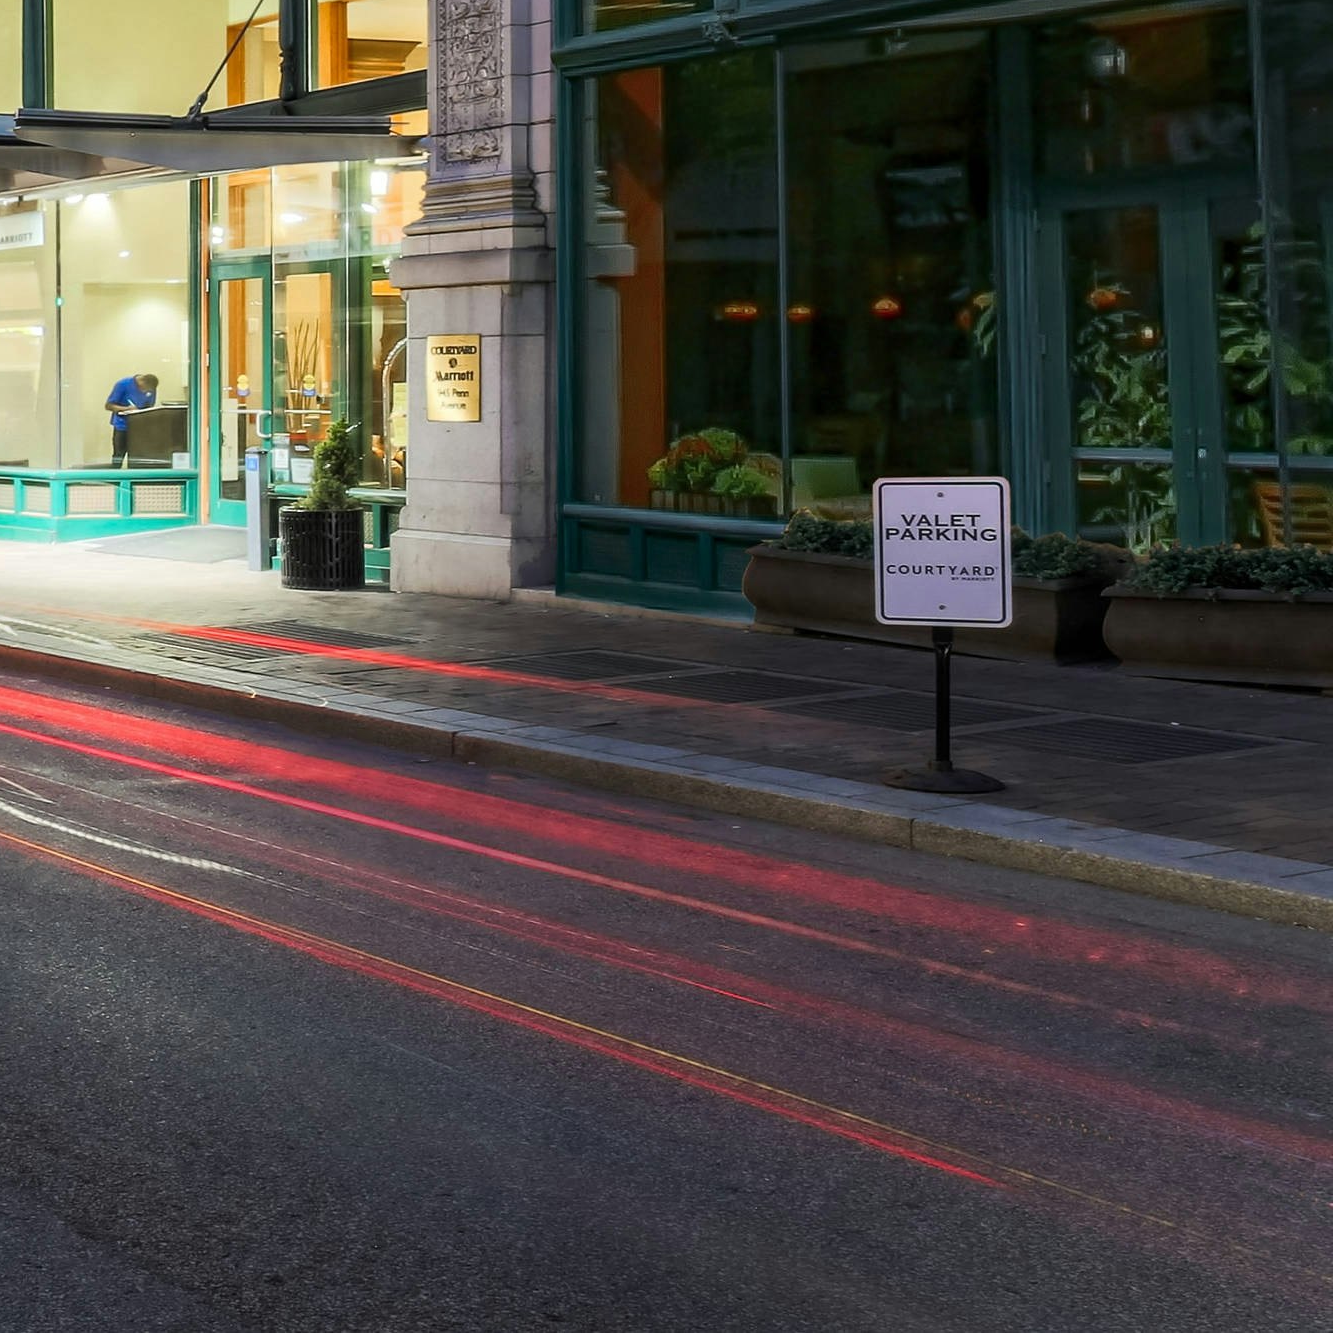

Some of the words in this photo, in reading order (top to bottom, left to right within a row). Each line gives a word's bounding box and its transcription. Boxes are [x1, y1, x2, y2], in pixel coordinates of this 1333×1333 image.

[435, 370, 474, 381] Marriott
[901, 514, 981, 527] VALET
[885, 528, 997, 541] PARKING
[886, 565, 995, 576] COURTYARD
